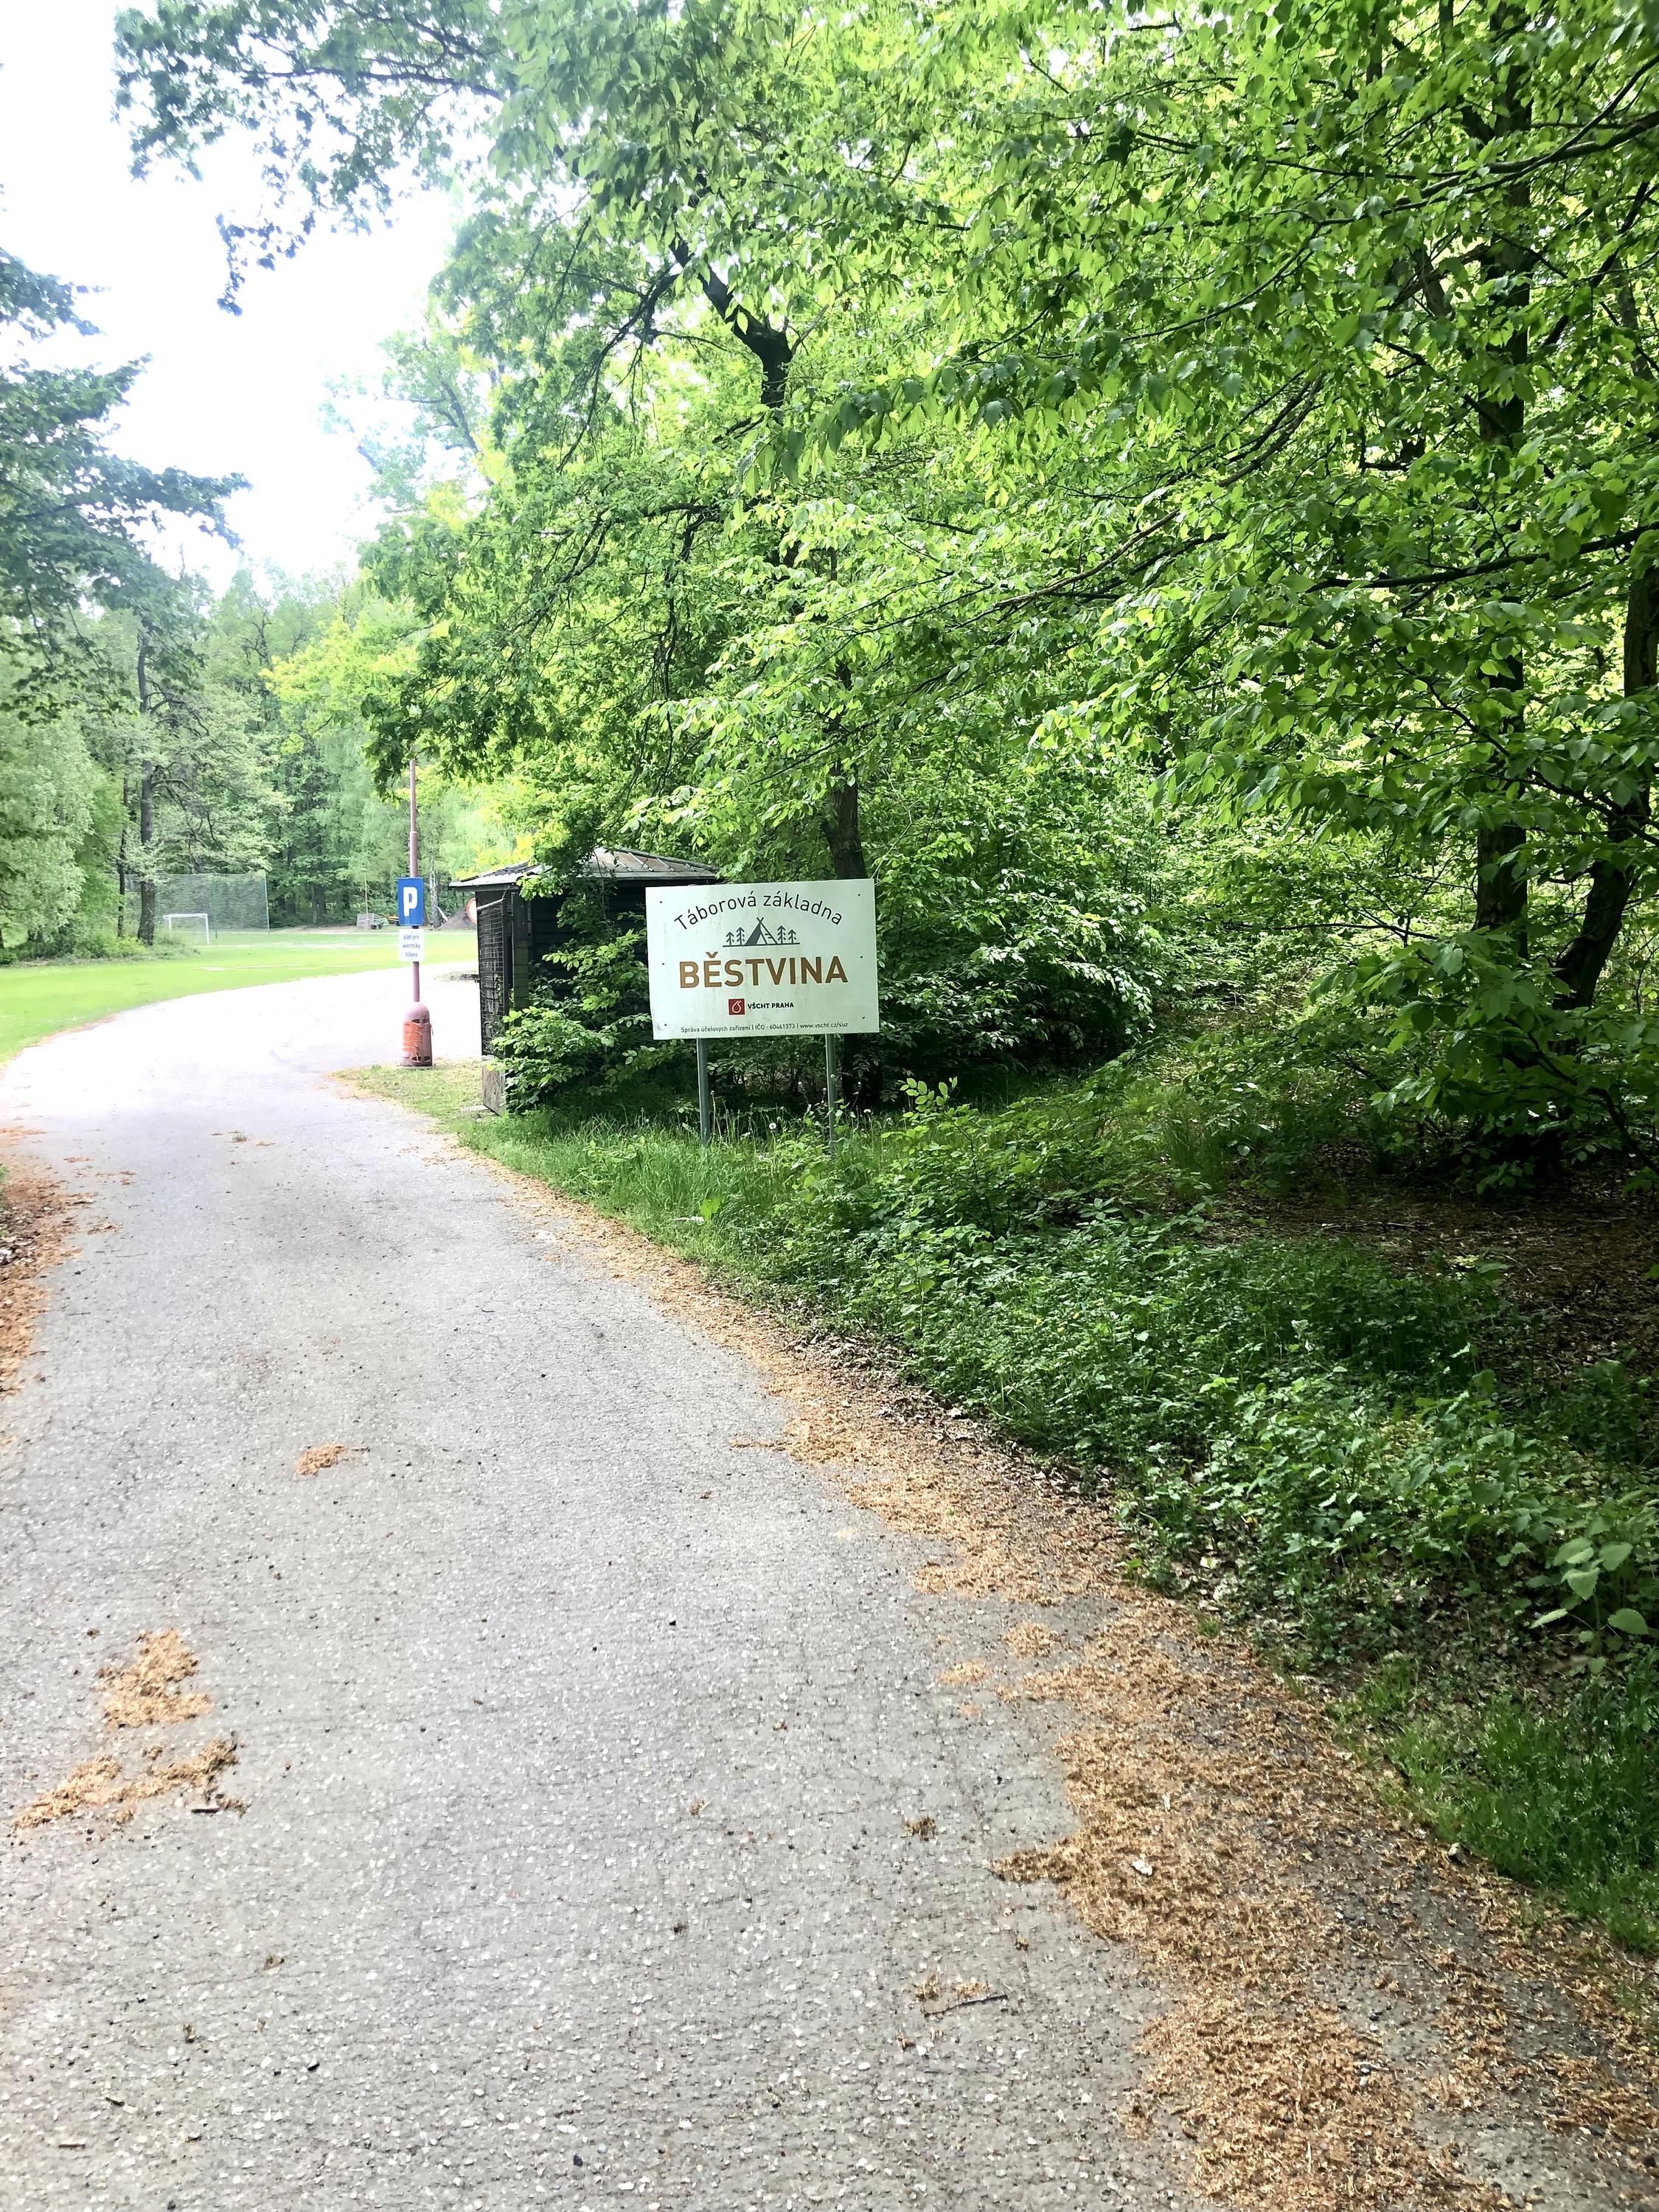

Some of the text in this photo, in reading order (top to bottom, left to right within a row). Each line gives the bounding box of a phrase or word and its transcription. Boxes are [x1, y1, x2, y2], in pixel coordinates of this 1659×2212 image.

[403, 886, 418, 917] P
[674, 891, 842, 931] Táborová základna
[679, 951, 849, 989] BĚSTVINA
[747, 1001, 770, 1009] VŠCHT
[701, 1025, 728, 1033] účelových
[755, 1022, 765, 1030] IČO
[770, 1022, 796, 1030] 60461373
